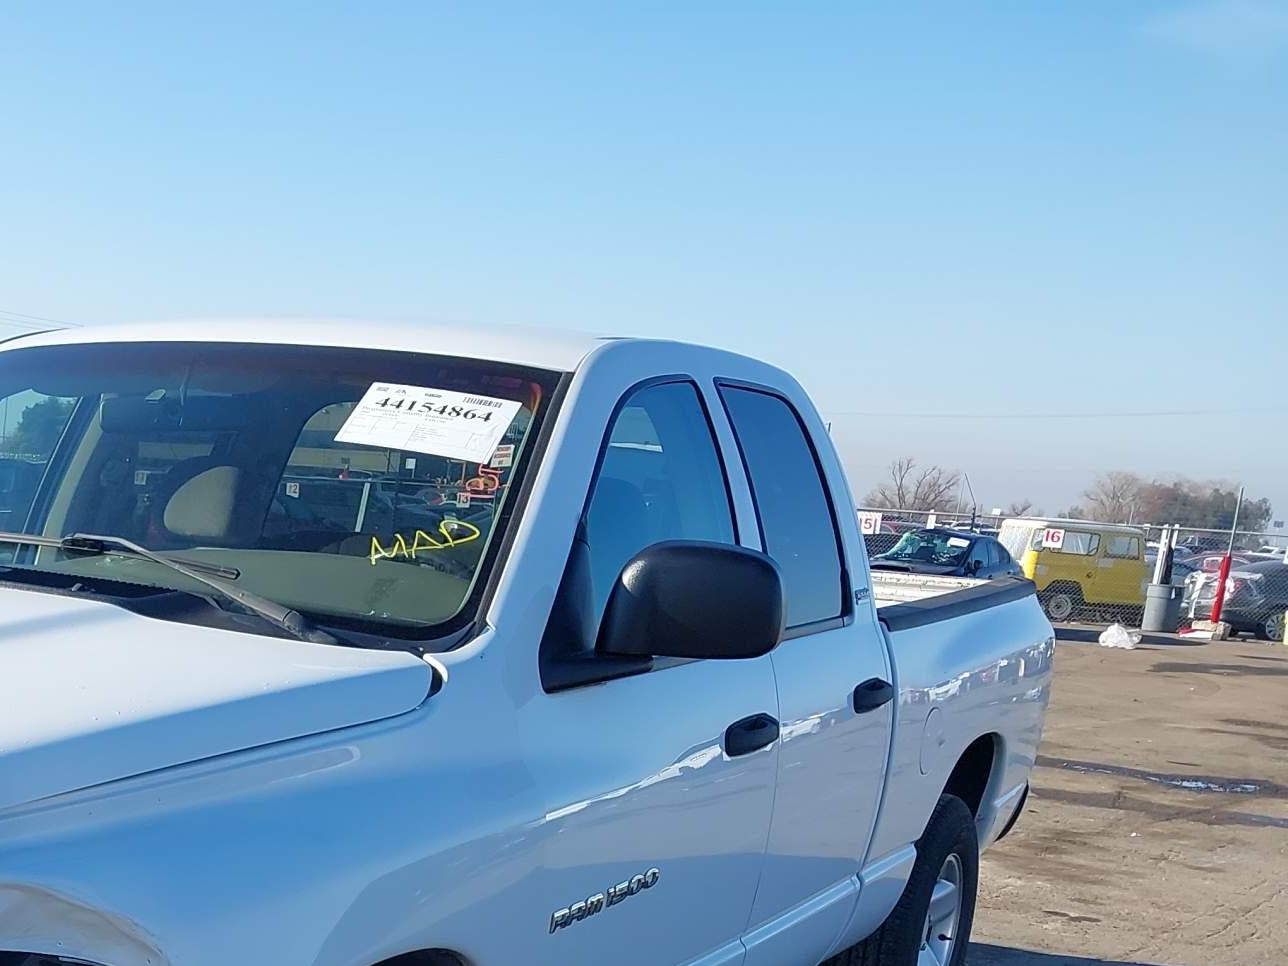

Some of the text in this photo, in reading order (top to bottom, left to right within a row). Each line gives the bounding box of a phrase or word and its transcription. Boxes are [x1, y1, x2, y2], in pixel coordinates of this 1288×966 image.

[374, 396, 494, 423] 44154864
[369, 519, 481, 566] MAD
[1045, 529, 1062, 543] 16
[605, 866, 661, 908] 1500
